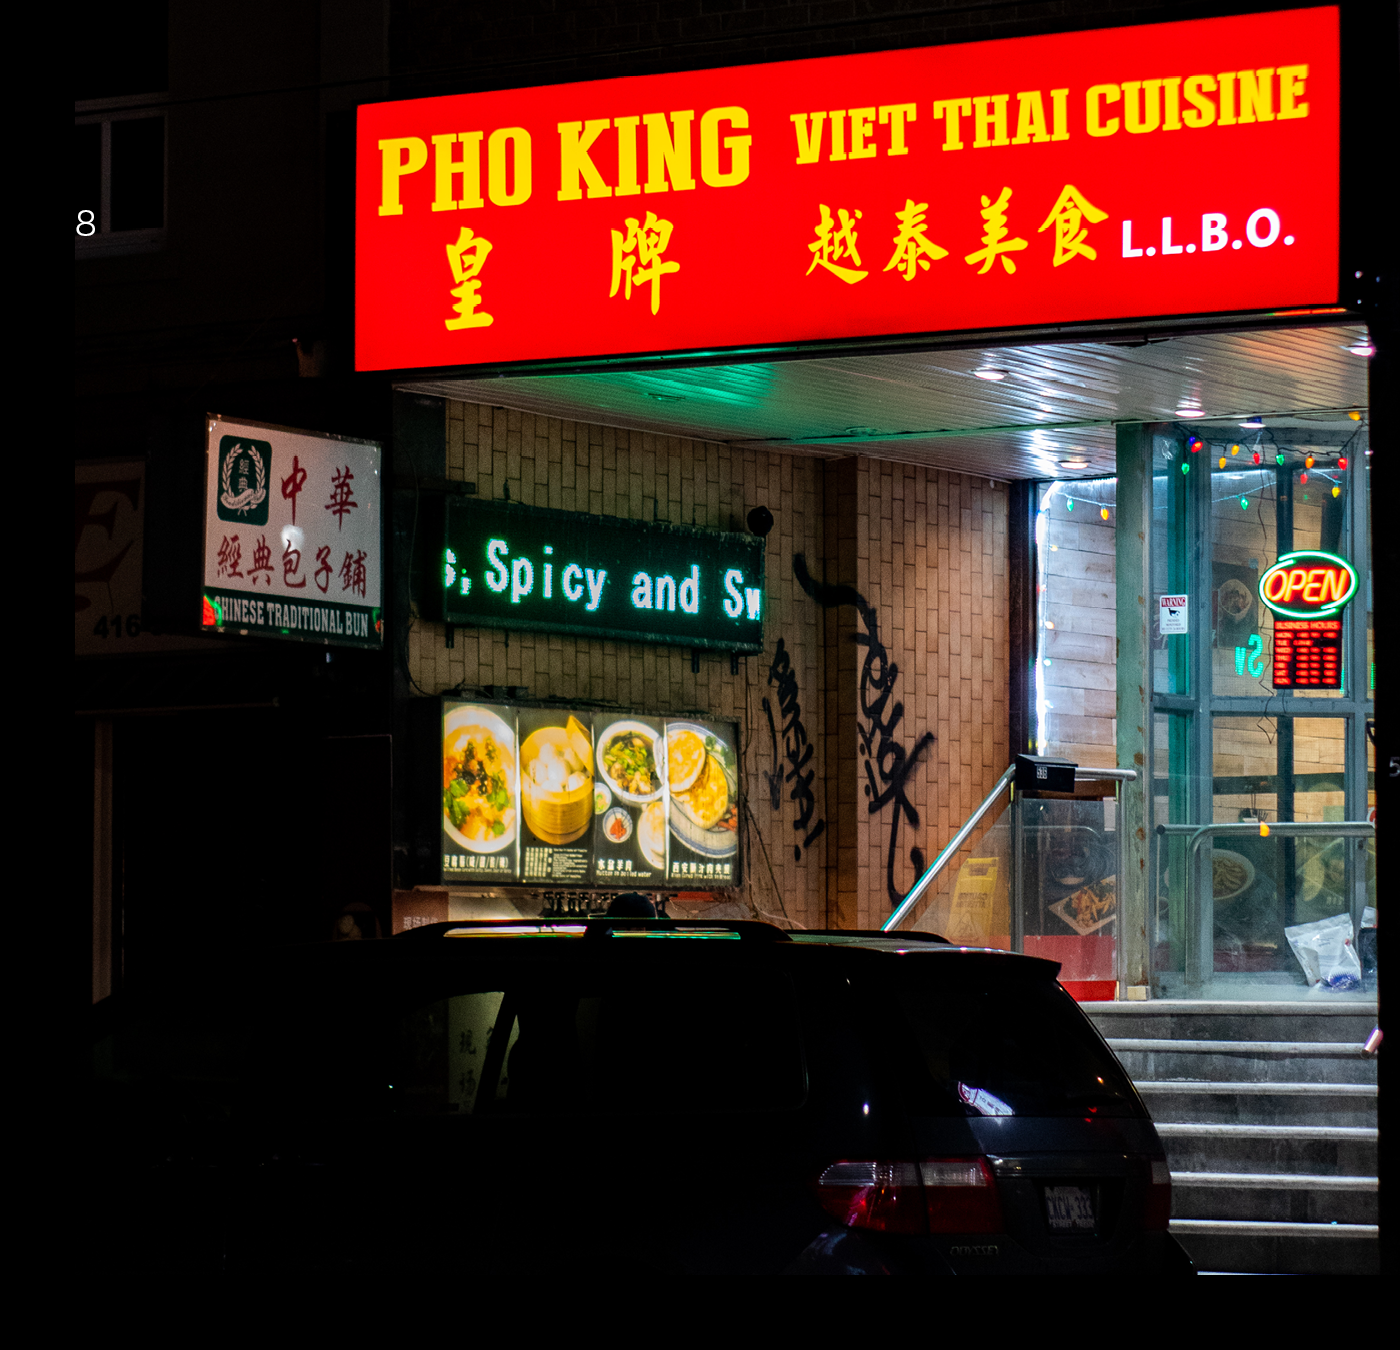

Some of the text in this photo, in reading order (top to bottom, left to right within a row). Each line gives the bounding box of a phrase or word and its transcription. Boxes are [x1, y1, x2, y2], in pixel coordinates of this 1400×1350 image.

[377, 63, 1310, 217] PHO KING VIET THAI CUISINE
[805, 184, 1110, 285] 越泰美食
[1121, 208, 1295, 259] L.L.B.O.
[281, 455, 358, 531] 中華
[485, 538, 607, 611] Spicy
[631, 564, 700, 615] and
[1162, 597, 1186, 607] WARNING
[1264, 569, 1351, 602] OPEN
[266, 602, 343, 633] TRADITIONAL
[346, 614, 369, 638] BUN
